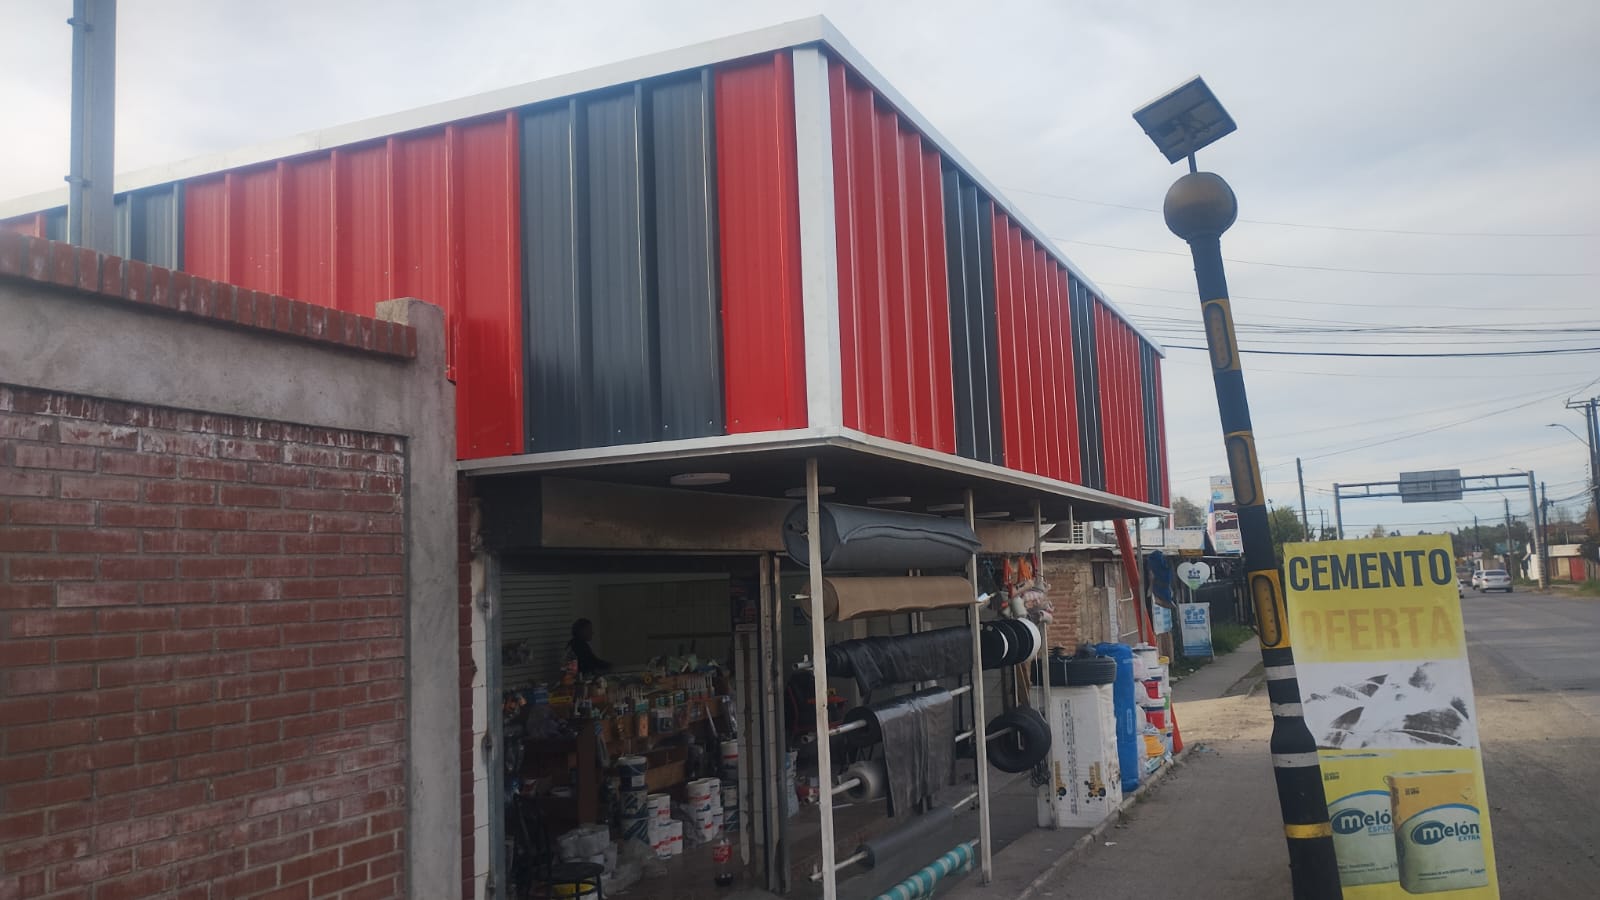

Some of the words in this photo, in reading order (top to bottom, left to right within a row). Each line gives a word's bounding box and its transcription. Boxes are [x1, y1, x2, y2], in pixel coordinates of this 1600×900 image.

[1289, 548, 1451, 591] CEMENTO
[1300, 606, 1456, 651] OFERTA
[1340, 809, 1392, 829] meló
[1368, 825, 1393, 833] ESPEC
[1422, 822, 1480, 841] melón
